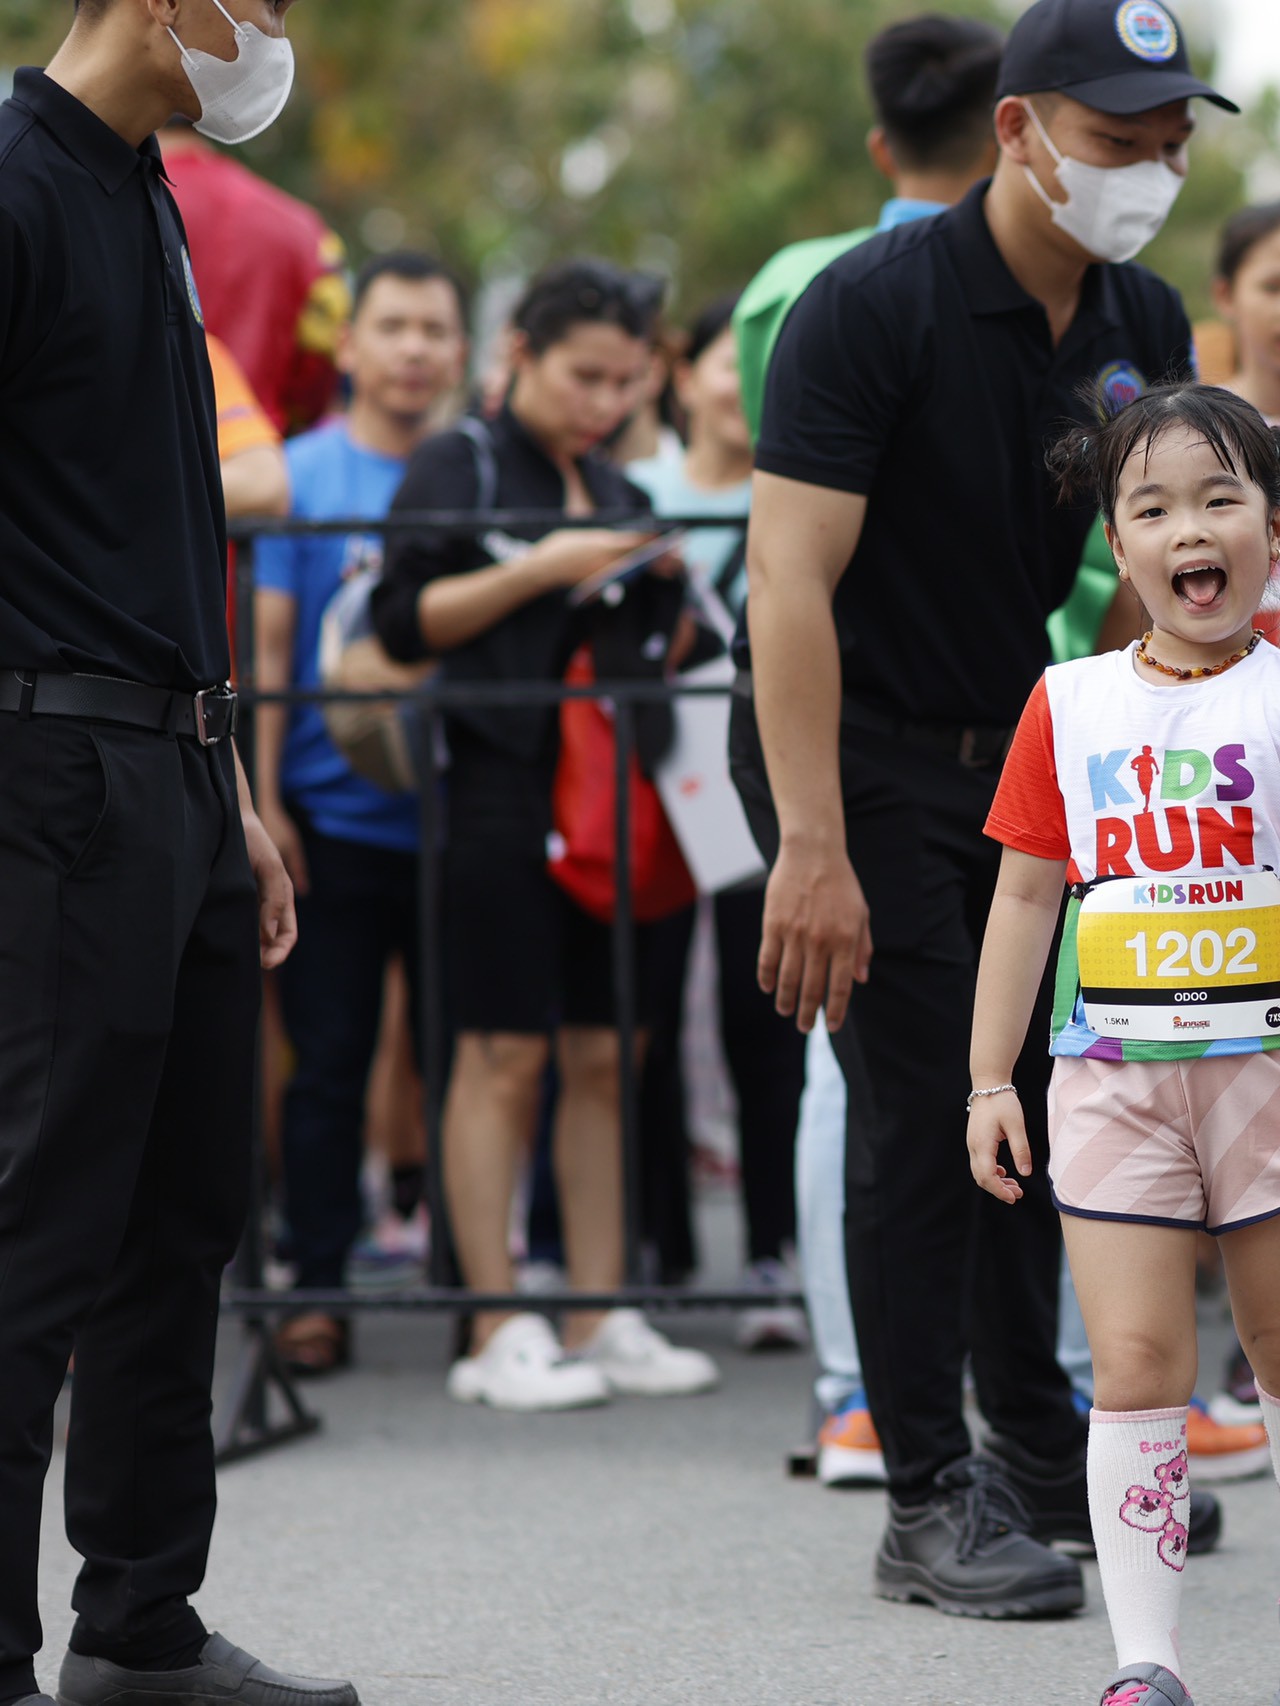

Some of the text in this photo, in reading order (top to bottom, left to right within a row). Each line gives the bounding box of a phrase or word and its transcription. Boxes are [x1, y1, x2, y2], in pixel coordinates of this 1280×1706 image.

[1096, 806, 1255, 875] RUN
[1125, 928, 1258, 977] 1202
[1174, 992, 1208, 1002] ODOO
[1104, 1017, 1130, 1026] 1.5KM
